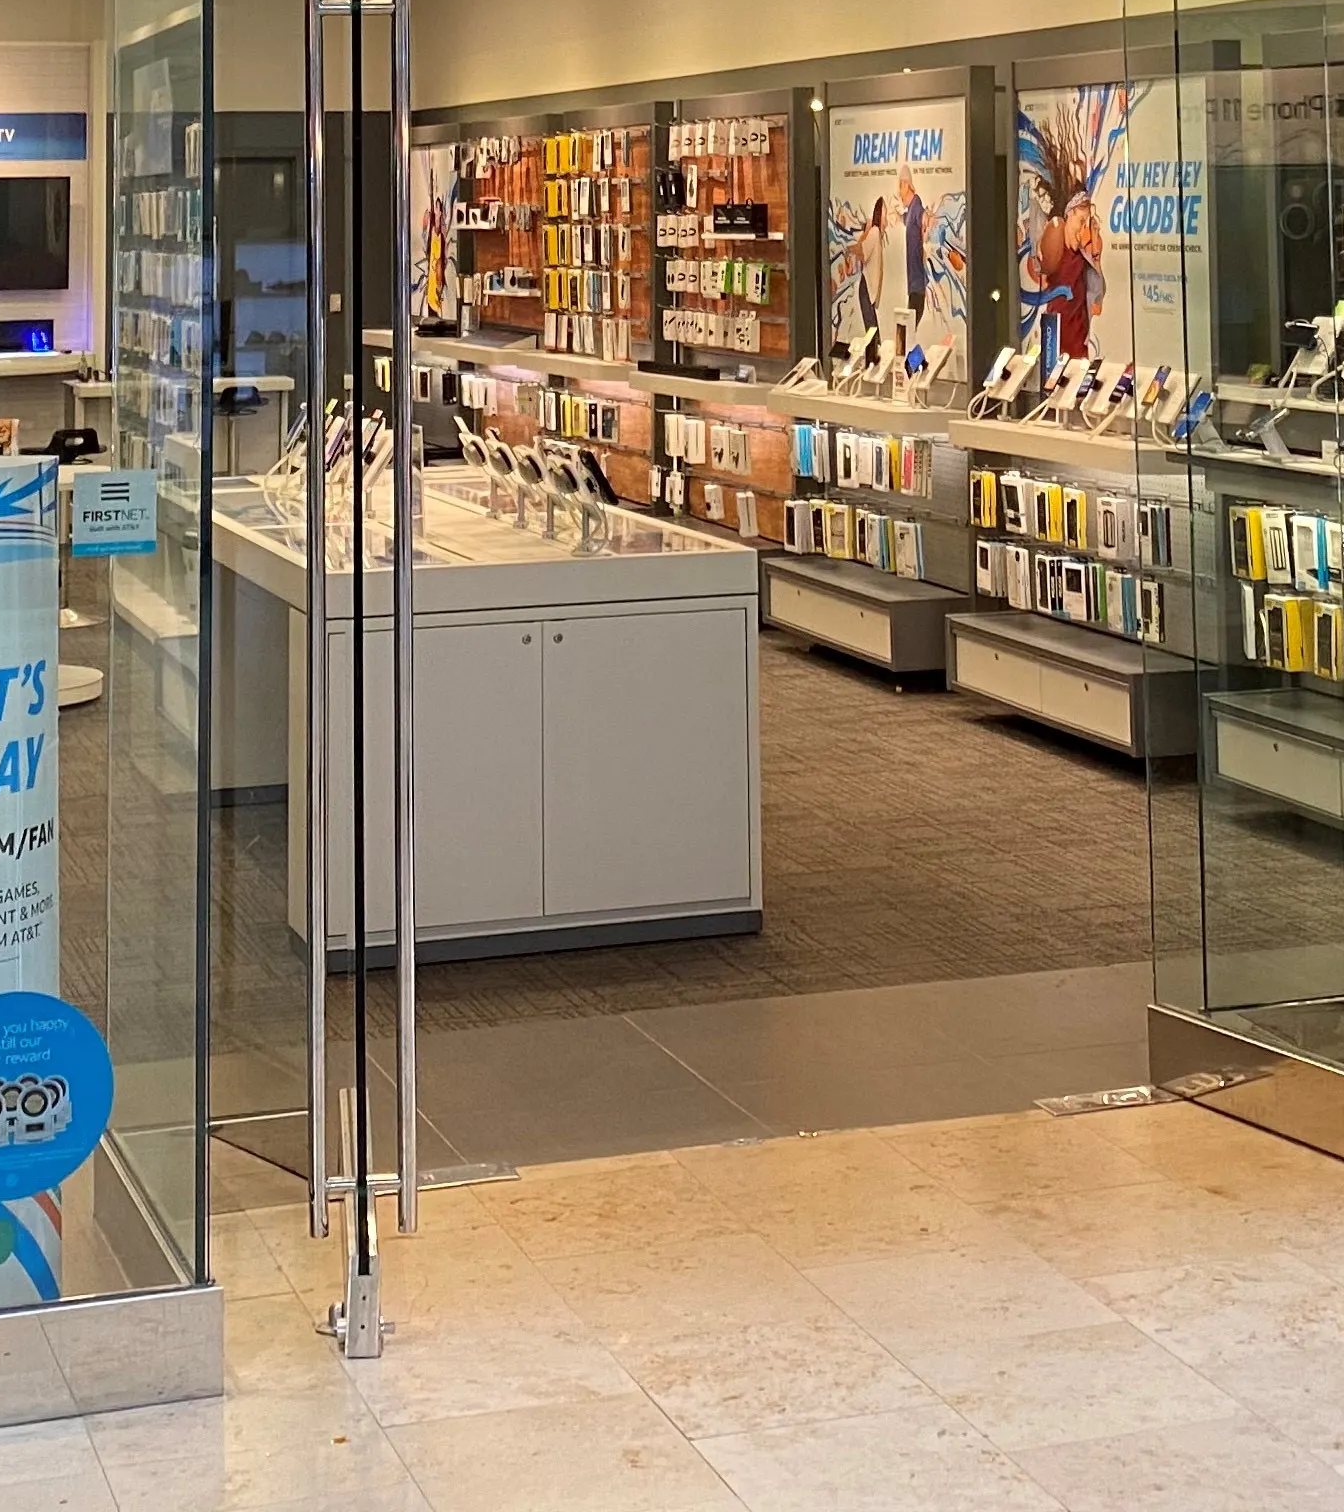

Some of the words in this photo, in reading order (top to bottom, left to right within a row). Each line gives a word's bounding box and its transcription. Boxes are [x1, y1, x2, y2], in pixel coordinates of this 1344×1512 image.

[853, 130, 899, 165] DREAM
[904, 128, 943, 162] TEAM
[19, 906, 29, 921] &
[3, 1023, 27, 1038] you
[30, 1018, 70, 1034] happy
[19, 1036, 43, 1048] our
[6, 1048, 51, 1065] reward
